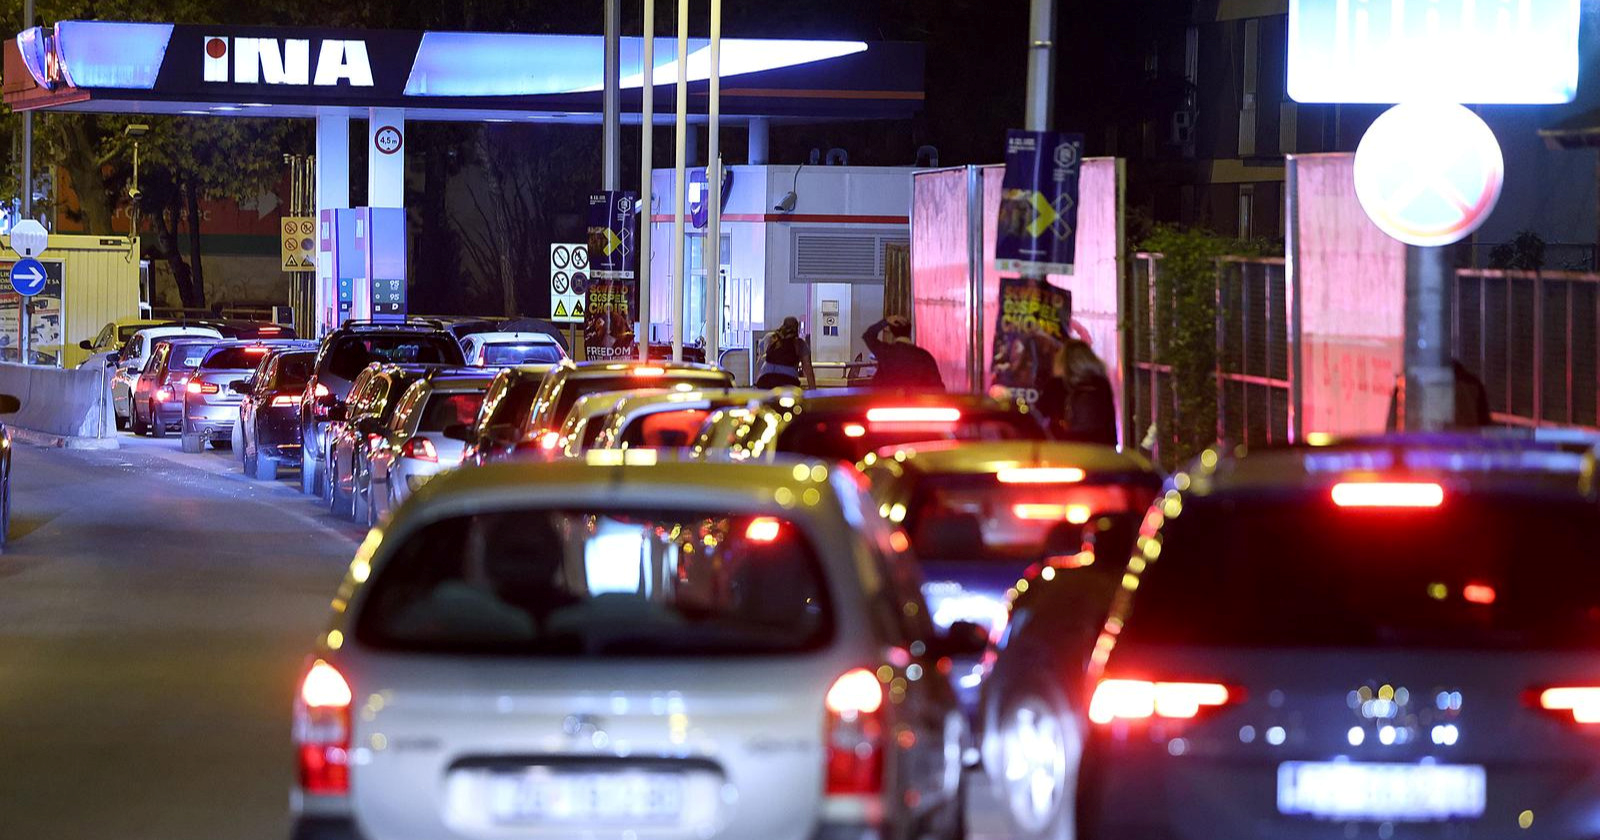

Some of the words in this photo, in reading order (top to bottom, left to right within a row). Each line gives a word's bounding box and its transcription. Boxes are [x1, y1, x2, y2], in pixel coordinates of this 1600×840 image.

[380, 136, 391, 145] 4,5
[389, 293, 400, 301] 95
[589, 293, 628, 303] GOSPEL
[589, 302, 628, 315] CHOIR
[587, 346, 631, 356] FREEDOM
